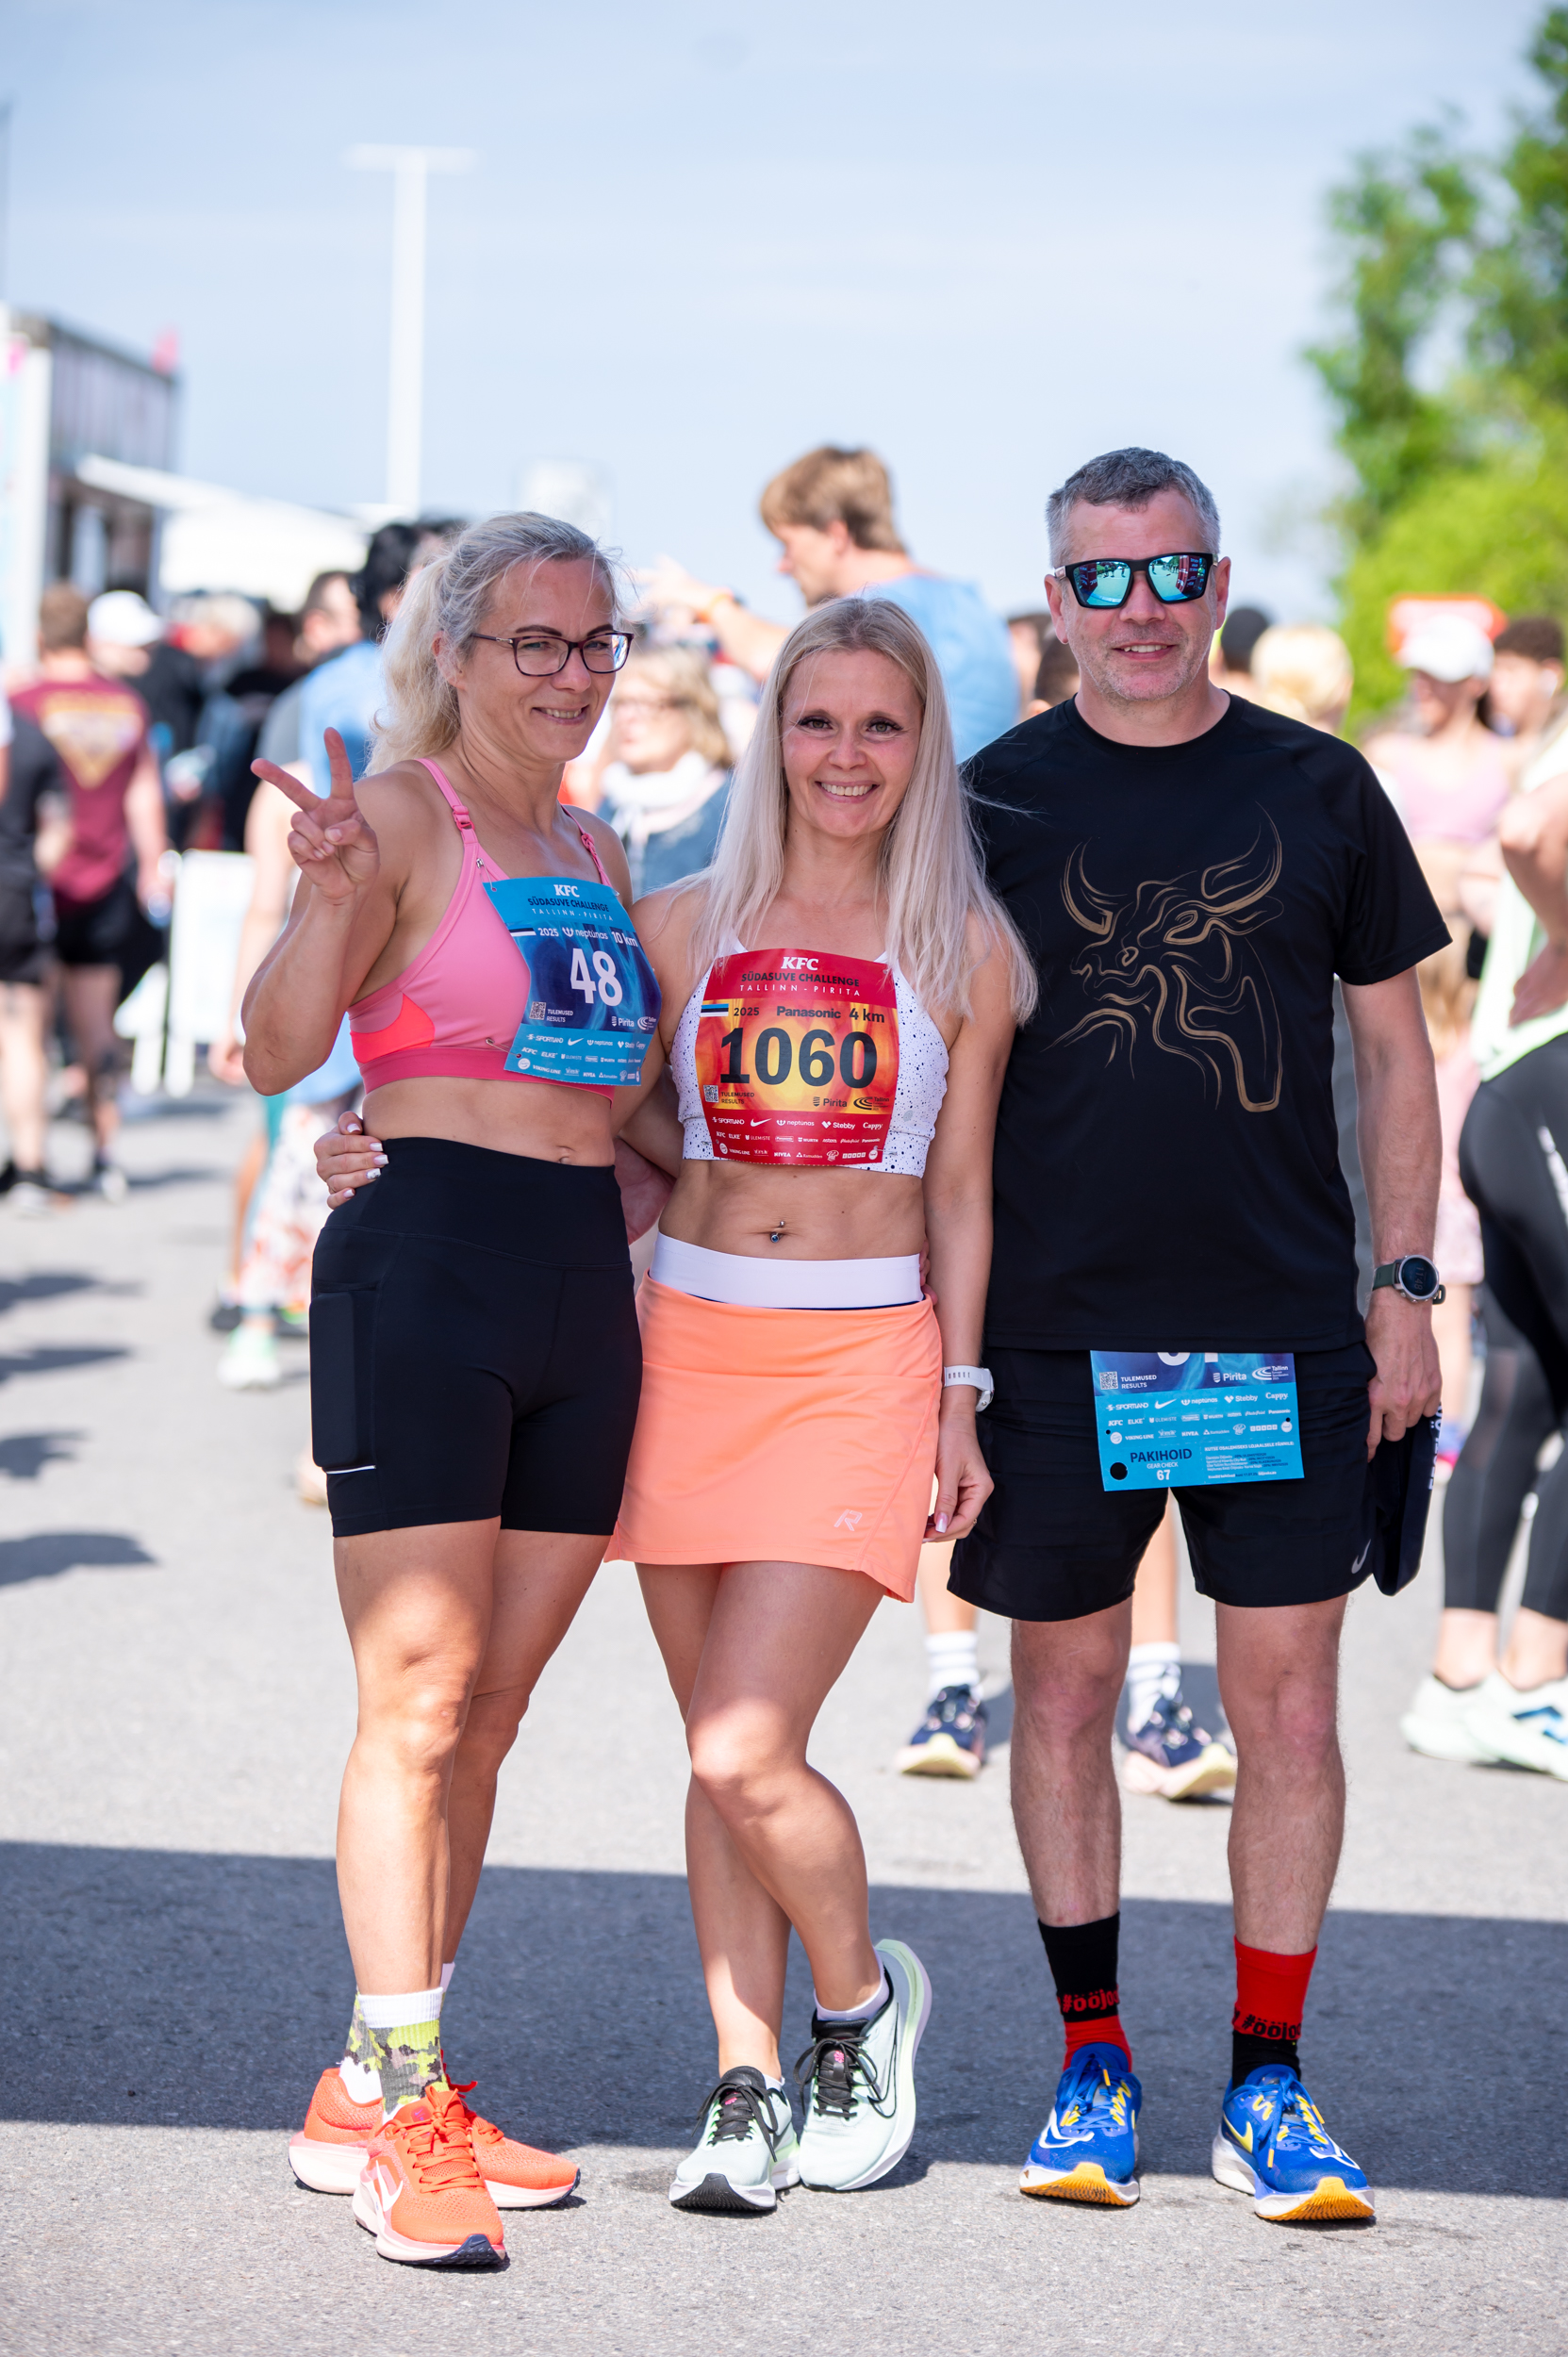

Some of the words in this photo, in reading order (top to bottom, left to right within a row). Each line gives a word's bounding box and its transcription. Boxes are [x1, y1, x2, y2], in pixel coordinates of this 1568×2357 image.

[553, 884, 580, 898] KFC
[528, 897, 569, 907] SÜDASUVE
[570, 900, 609, 912] CHALLENGE
[532, 908, 575, 916] TALLINN
[584, 912, 613, 921] PIRITA
[538, 928, 559, 937] 2025
[612, 931, 623, 944] 10
[623, 932, 638, 947] km
[781, 956, 818, 970] KFC
[570, 948, 623, 1007] 48
[741, 971, 796, 982] SÜDASUVE
[799, 973, 859, 987] CHALLENGE
[814, 986, 860, 997] PIRITA
[734, 1007, 759, 1016] 2025
[777, 1006, 841, 1019] Panasonic
[849, 1008, 859, 1020] 4
[863, 1009, 884, 1023] km
[619, 1017, 635, 1027] Pirita
[719, 1027, 877, 1089] 1060
[823, 1097, 848, 1108] Pirita
[1223, 1373, 1246, 1381] Pirita
[1265, 1392, 1288, 1400] Cappy
[1115, 1402, 1148, 1410] SPORTLAND
[1130, 1448, 1193, 1463] PAKIHOID
[1156, 1469, 1171, 1481] 67
